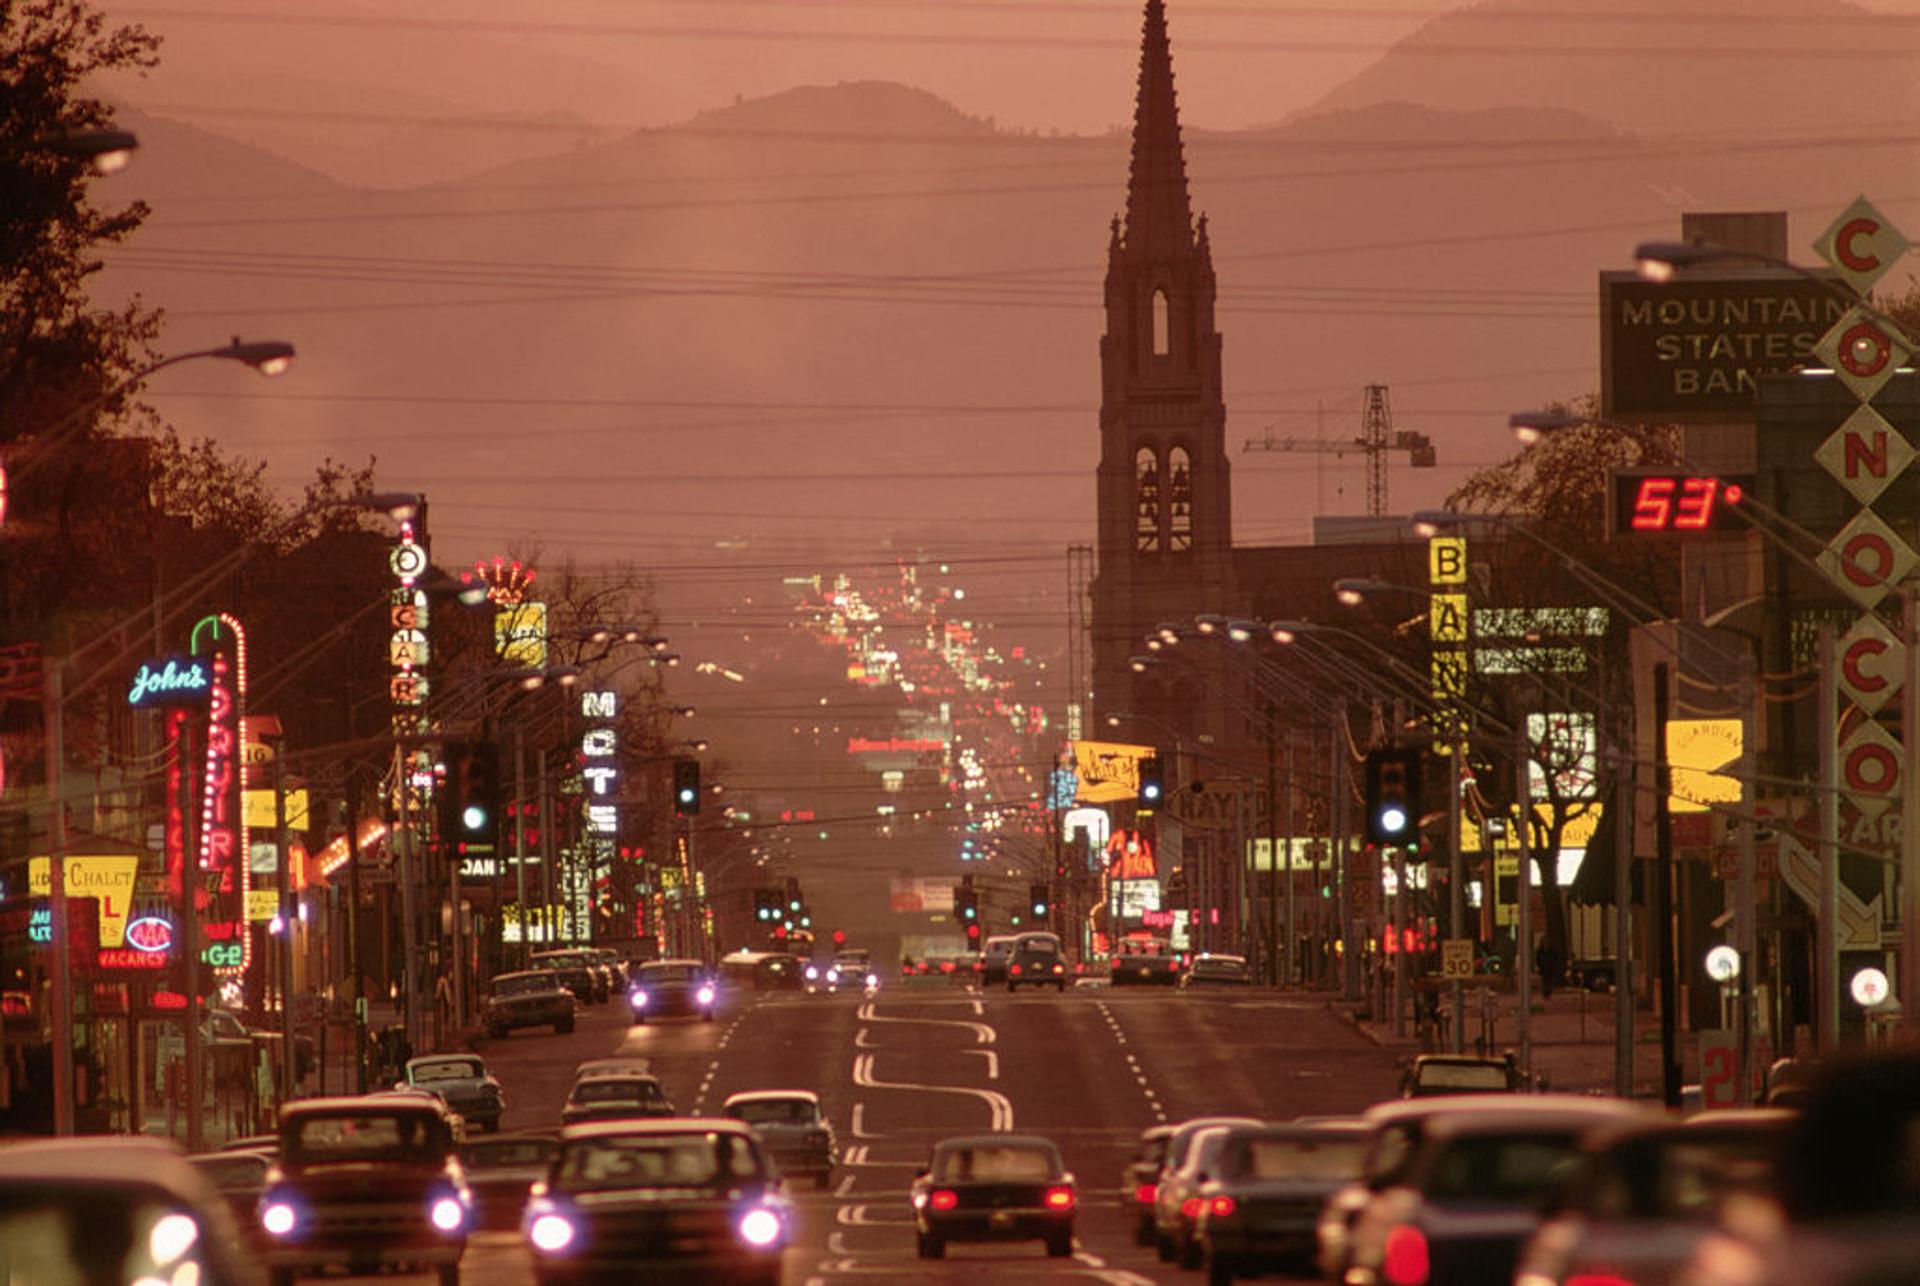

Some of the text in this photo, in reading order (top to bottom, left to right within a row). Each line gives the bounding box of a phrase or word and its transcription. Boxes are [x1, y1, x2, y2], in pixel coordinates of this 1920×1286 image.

[1621, 298, 1847, 325] MOUNTAIN
[1655, 332, 1815, 362] STATES
[1673, 366, 1772, 397] BAN
[1834, 217, 1899, 794] CONOCO
[583, 691, 617, 870] MOTE
[98, 951, 168, 968] VACANCY
[1446, 960, 1471, 975] 30
